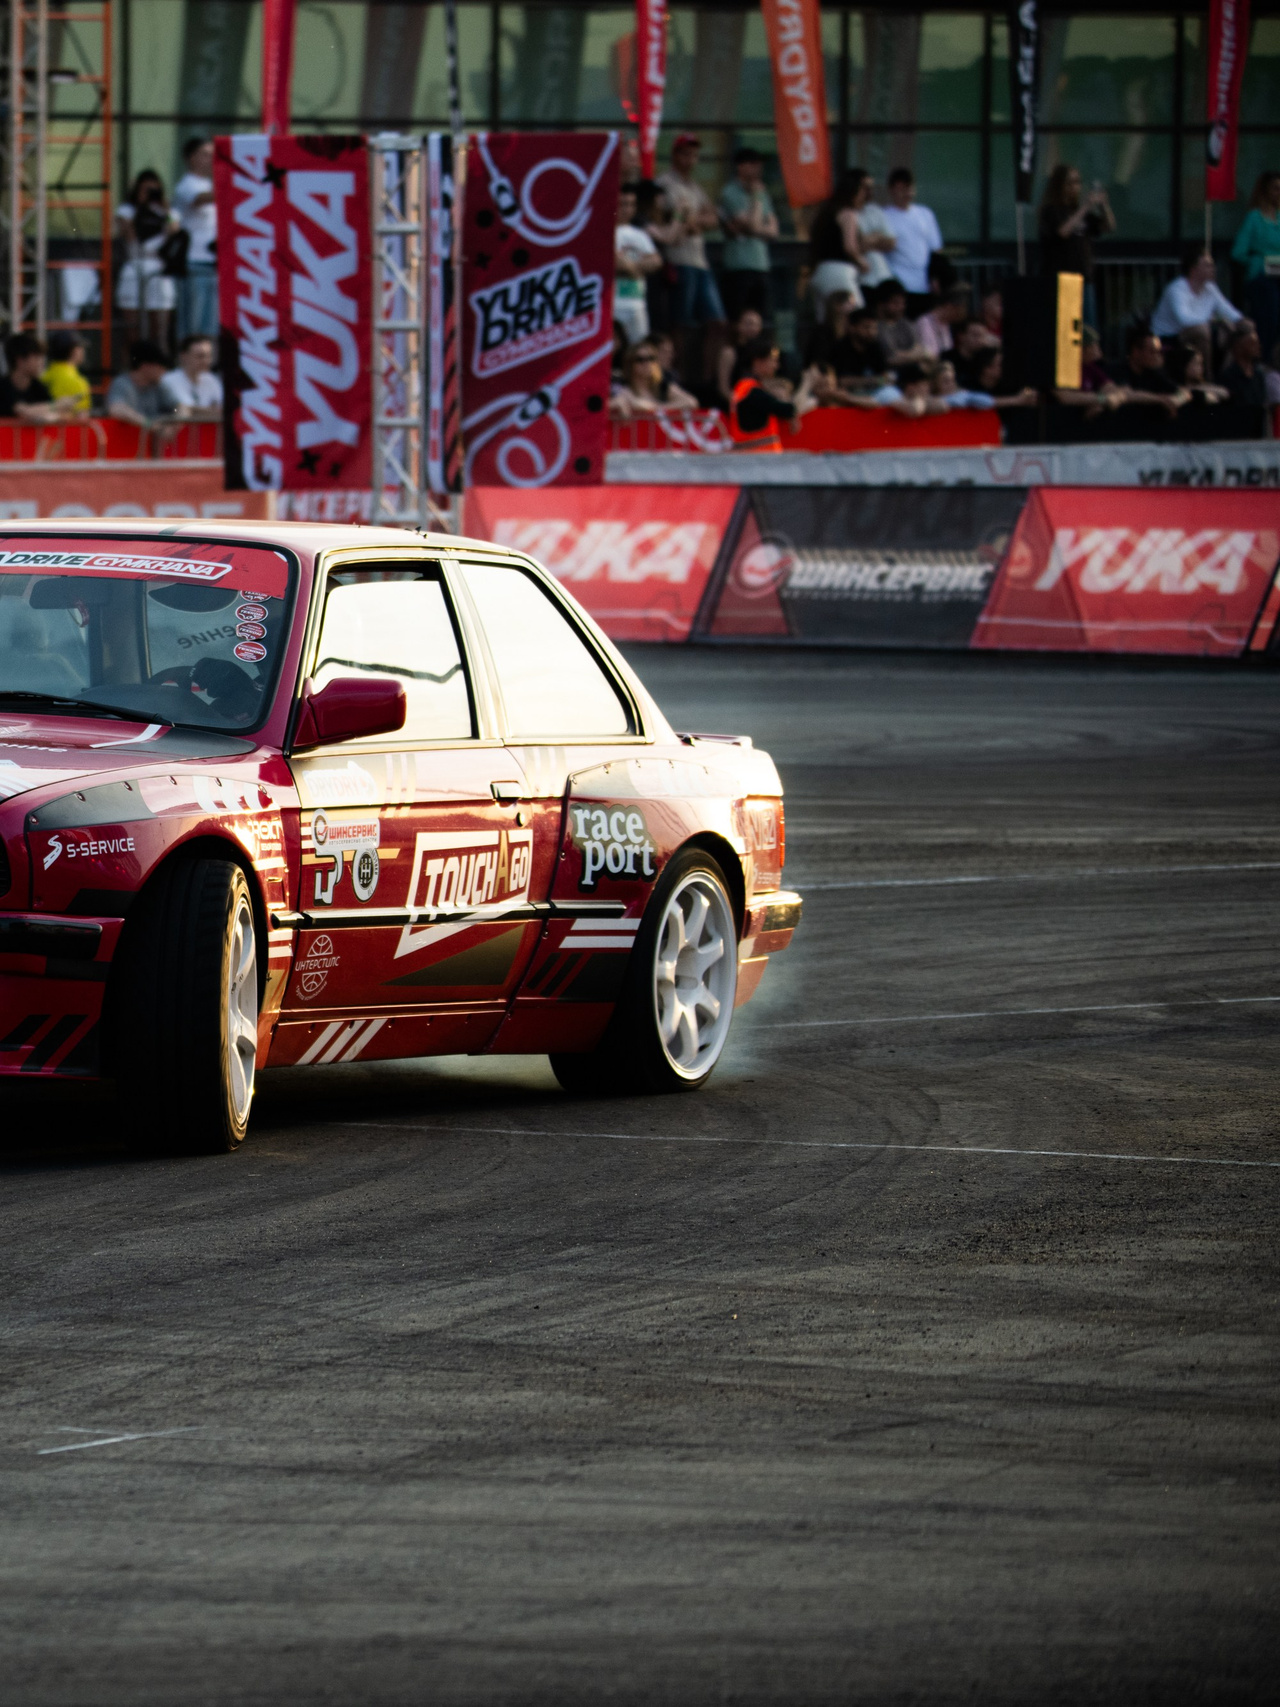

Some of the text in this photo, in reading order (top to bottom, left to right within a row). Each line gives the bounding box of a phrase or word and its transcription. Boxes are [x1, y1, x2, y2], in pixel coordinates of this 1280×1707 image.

[231, 135, 282, 491] GYMKHANA
[286, 171, 360, 449] YUKA
[476, 263, 577, 318] YUKA
[481, 282, 597, 351] DRIVE
[3, 553, 91, 566] DRIVE
[93, 556, 215, 576] GYMKHANA
[1035, 527, 1256, 595] YUKA
[66, 837, 136, 858] S-SERVICE
[328, 824, 378, 840] ШИНСЕРВИС
[574, 808, 644, 842] race
[581, 840, 655, 885] port
